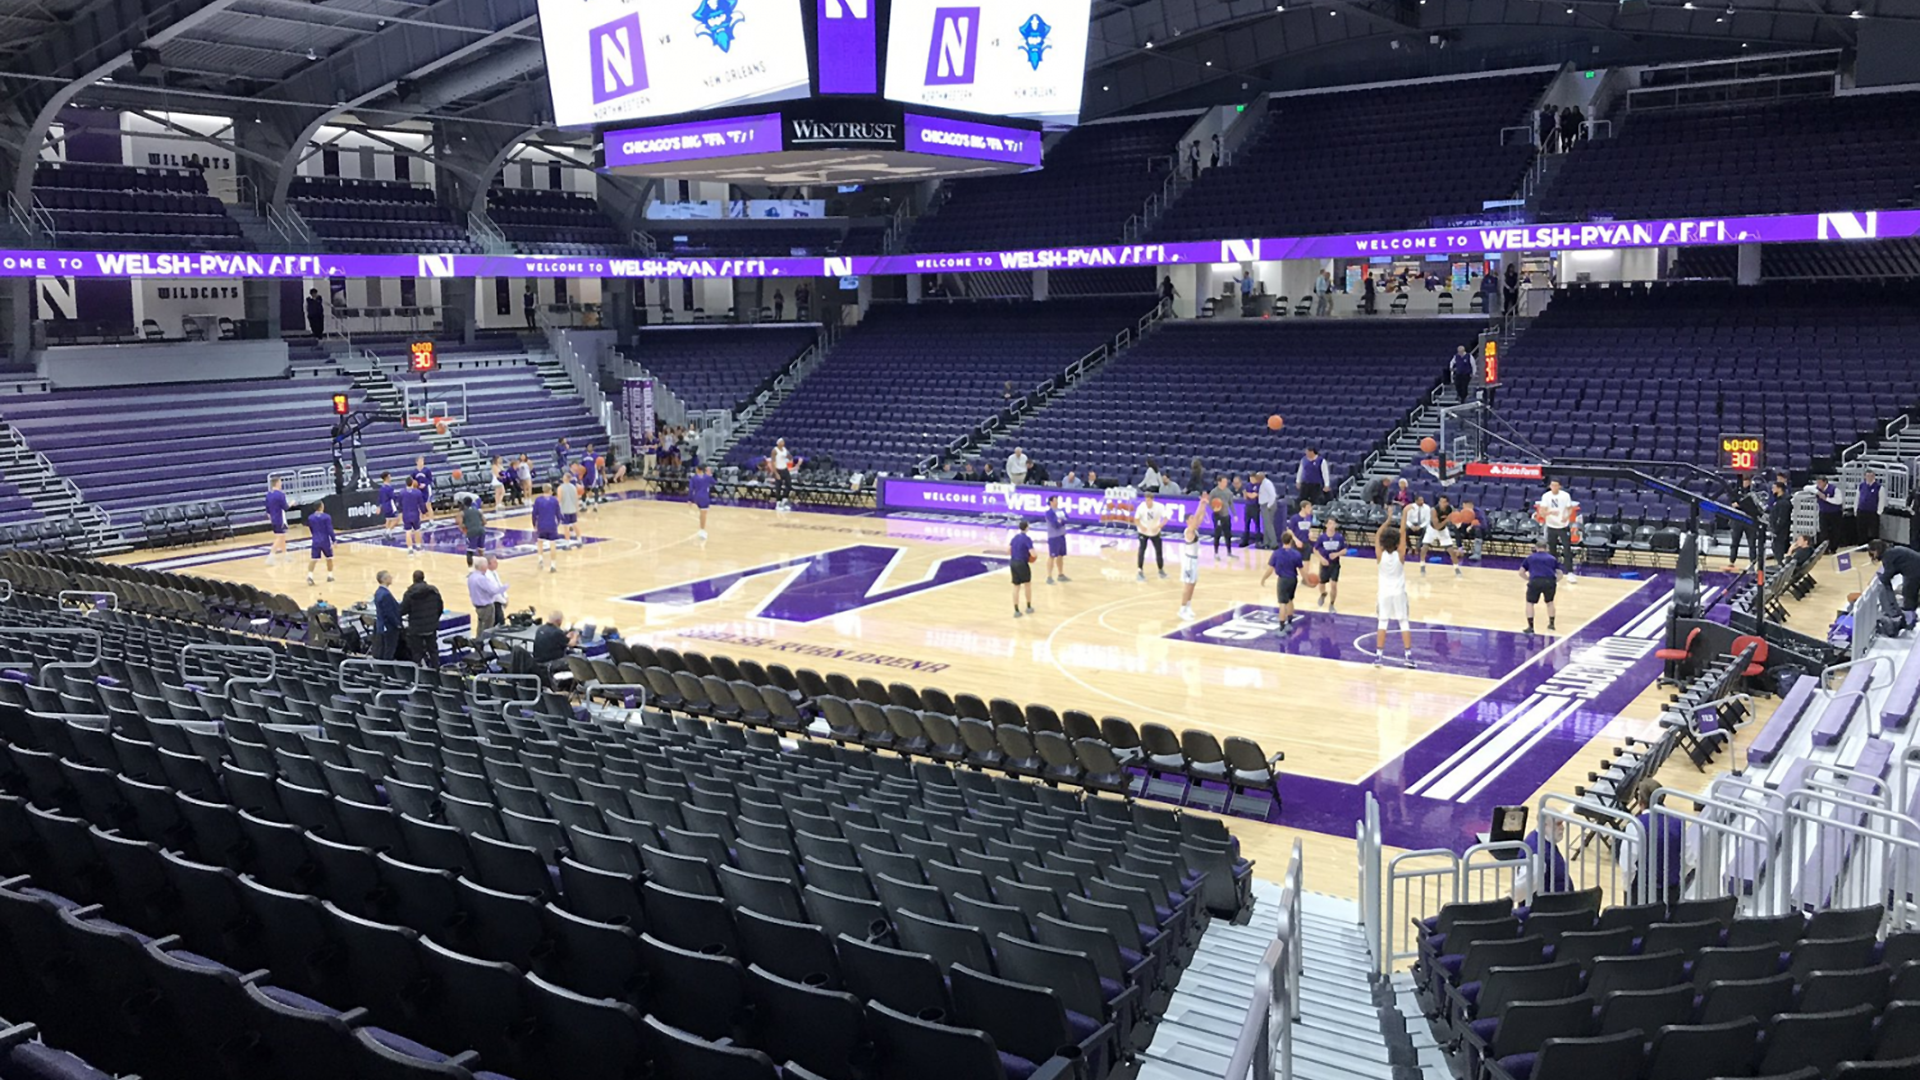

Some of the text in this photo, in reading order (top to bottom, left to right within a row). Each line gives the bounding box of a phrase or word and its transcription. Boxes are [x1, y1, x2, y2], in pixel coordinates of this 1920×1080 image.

[937, 17, 969, 77] N
[601, 26, 634, 93] N
[725, 60, 767, 83] ORLEANS
[1817, 211, 1877, 239] N
[1356, 236, 1437, 251] WELCOME
[1447, 236, 1468, 247] TO
[1480, 225, 1652, 250] WELSH-RYAN
[1221, 238, 1260, 262] N
[58, 258, 83, 270] TO
[96, 253, 264, 275] WELSH-RYAN
[418, 255, 455, 277] N
[526, 262, 584, 273] WELCOME
[589, 262, 603, 272] TO
[824, 257, 852, 277] N
[915, 258, 972, 269] WELCOME
[977, 257, 993, 267] TO
[36, 276, 78, 320] N
[157, 286, 239, 299] WILDCATS
[415, 352, 431, 368] 30
[1732, 453, 1751, 468] 30
[923, 491, 977, 504] WELCOME
[348, 501, 377, 518] meije
[846, 651, 951, 673] ARENA
